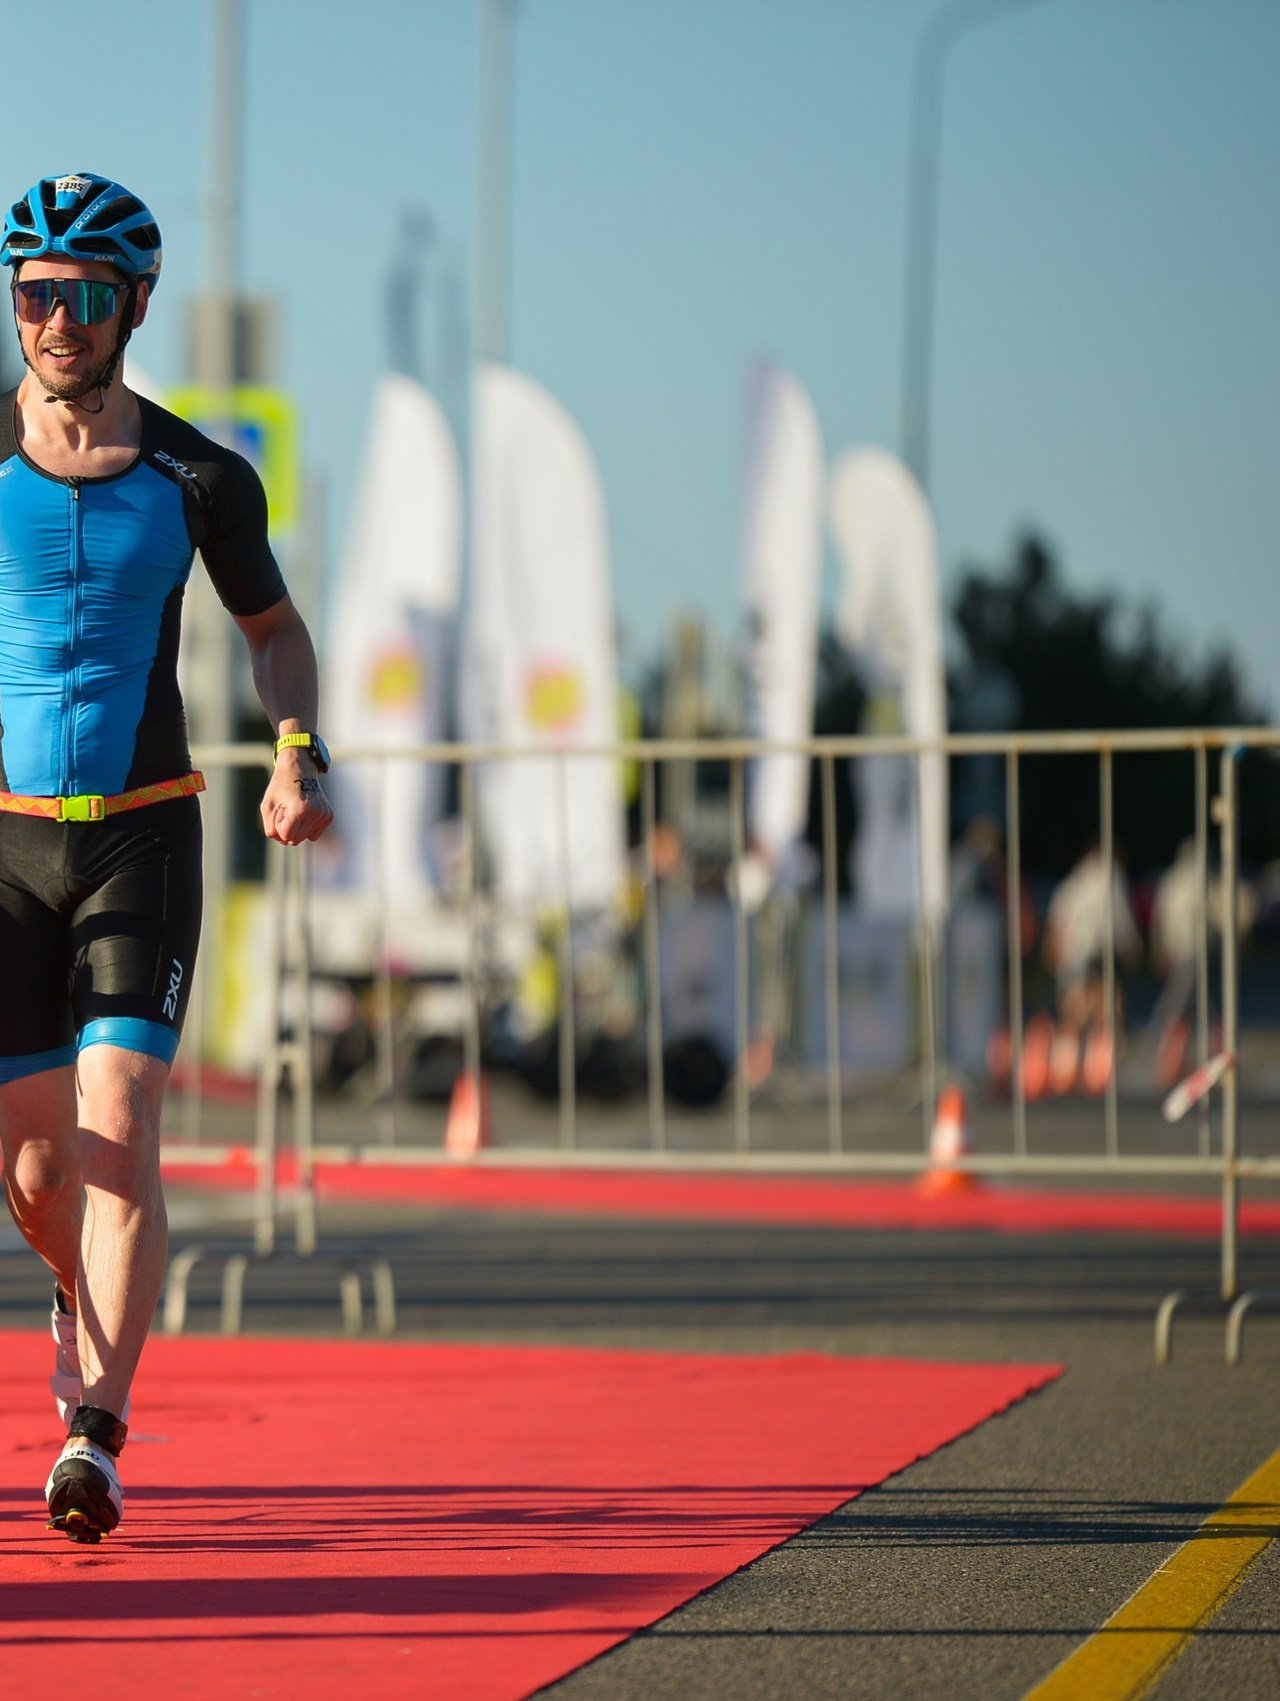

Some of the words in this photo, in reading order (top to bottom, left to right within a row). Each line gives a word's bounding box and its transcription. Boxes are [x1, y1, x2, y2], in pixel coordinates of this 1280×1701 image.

[57, 181, 85, 192] 2385
[153, 449, 198, 479] 2XU
[162, 957, 183, 1022] 2XU
